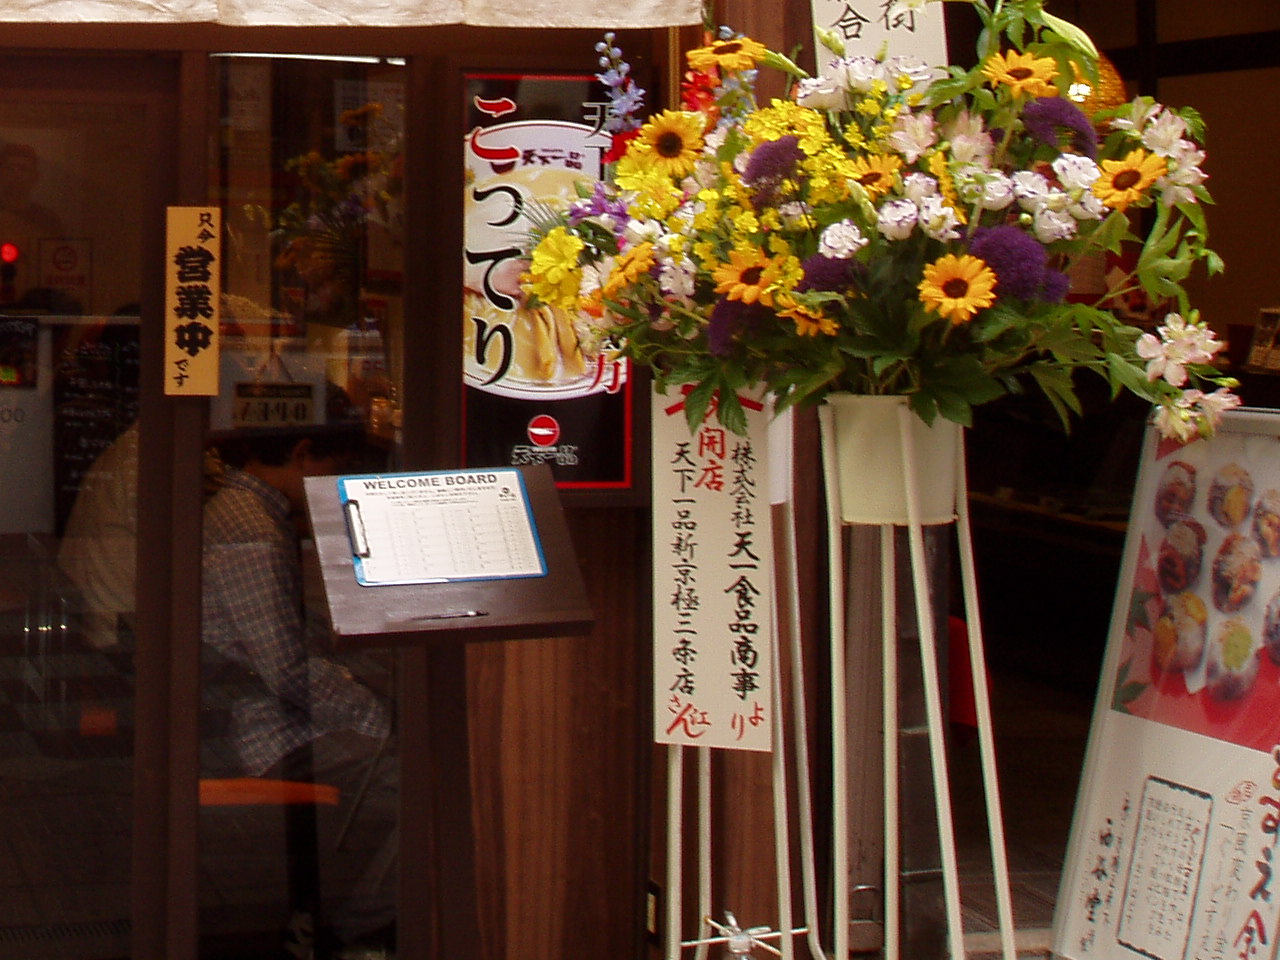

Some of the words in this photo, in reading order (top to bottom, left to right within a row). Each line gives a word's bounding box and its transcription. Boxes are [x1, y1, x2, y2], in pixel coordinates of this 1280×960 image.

[173, 245, 216, 358] 営業中
[464, 94, 525, 388] こってり
[362, 475, 440, 491] WELCOME
[445, 472, 499, 487] BOARD
[669, 441, 701, 696] 天下一品新京極三条店
[723, 440, 762, 701] 株式会社天一食品商事
